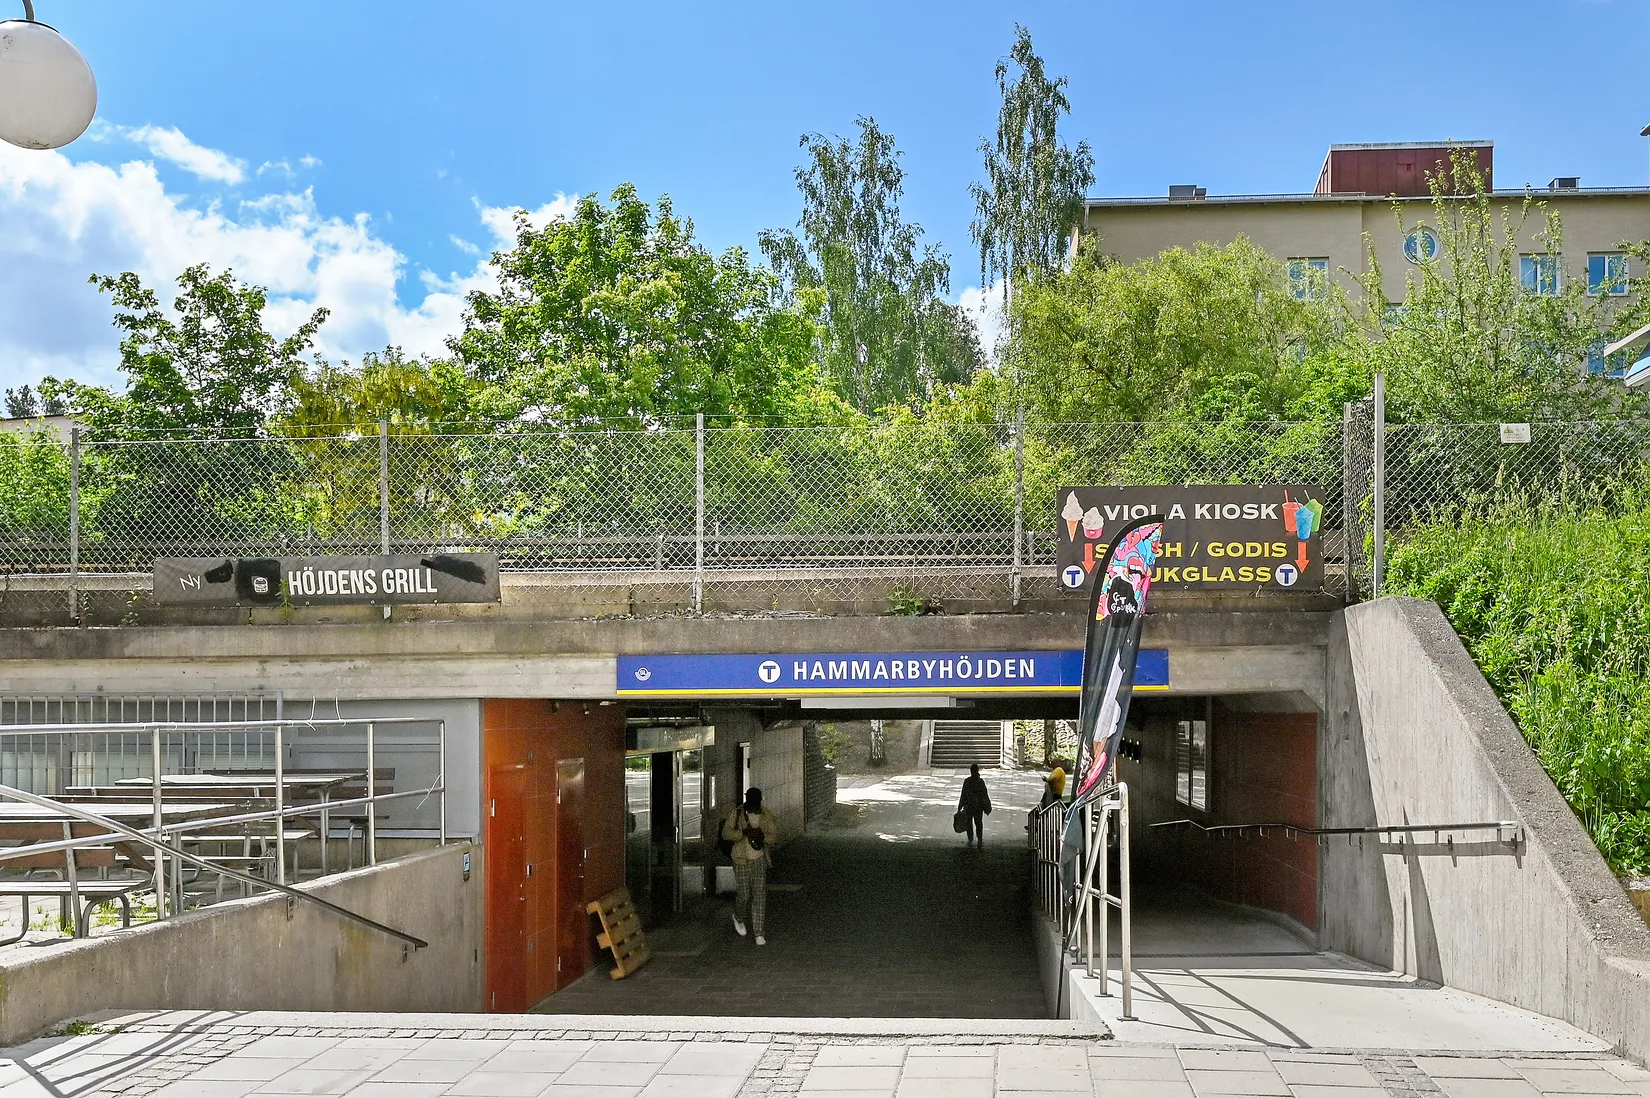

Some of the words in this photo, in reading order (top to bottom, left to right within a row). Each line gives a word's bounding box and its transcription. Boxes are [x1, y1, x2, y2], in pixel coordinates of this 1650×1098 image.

[1103, 503, 1186, 520] VIOLA
[1195, 503, 1278, 520] KIOSK
[1207, 542, 1287, 558] GODIS
[288, 566, 378, 596] HÖJDENS
[381, 568, 438, 594] GRILL
[793, 656, 1036, 680] HAMMARBYHÖJDEN
